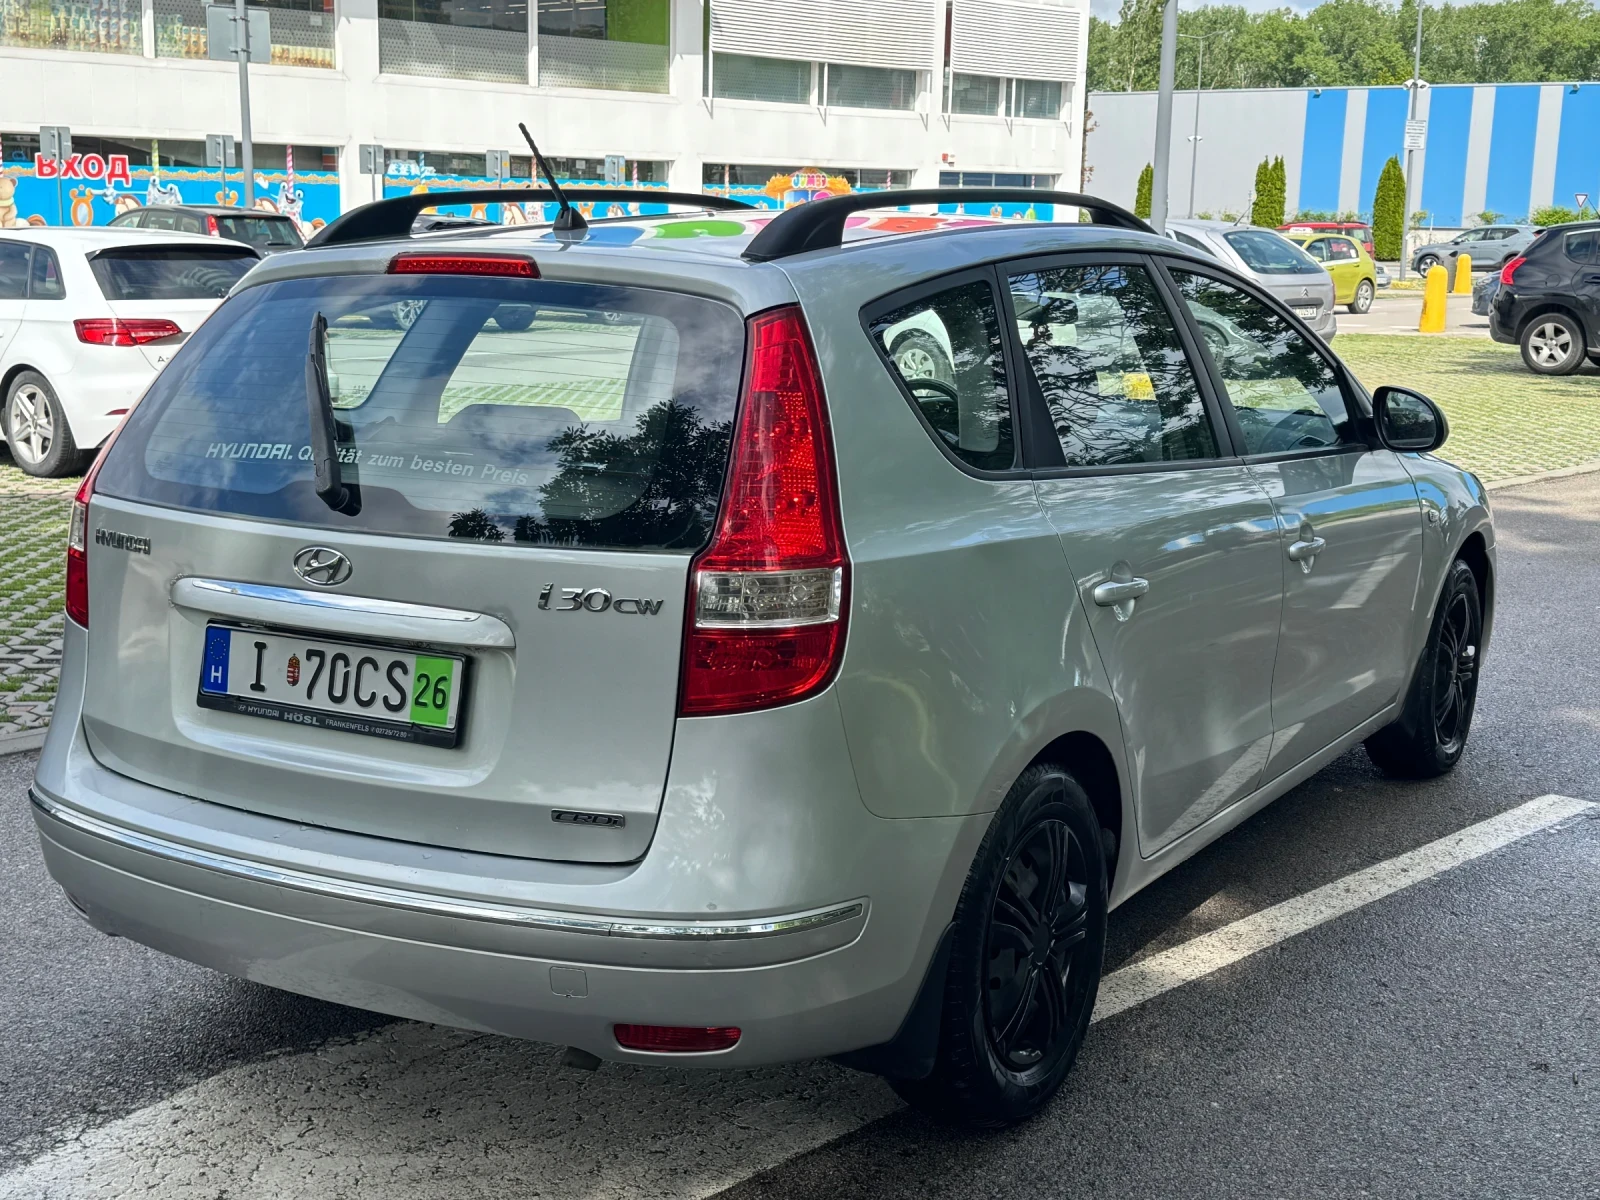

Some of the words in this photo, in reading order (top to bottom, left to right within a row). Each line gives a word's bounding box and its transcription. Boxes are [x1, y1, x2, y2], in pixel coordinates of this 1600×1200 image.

[35, 153, 132, 187] ВХОД
[298, 446, 362, 464] Qität
[367, 453, 404, 467] zum
[410, 455, 475, 476] besten
[480, 463, 529, 485] Preis
[96, 528, 151, 555] HYUNDAI
[210, 665, 222, 684] H
[250, 641, 268, 692] I
[306, 648, 409, 712] 70CS
[414, 673, 449, 710] 26
[247, 706, 280, 717] HYUNDAI
[283, 712, 320, 725] HÖSL
[325, 718, 370, 732] FRANKENFELS
